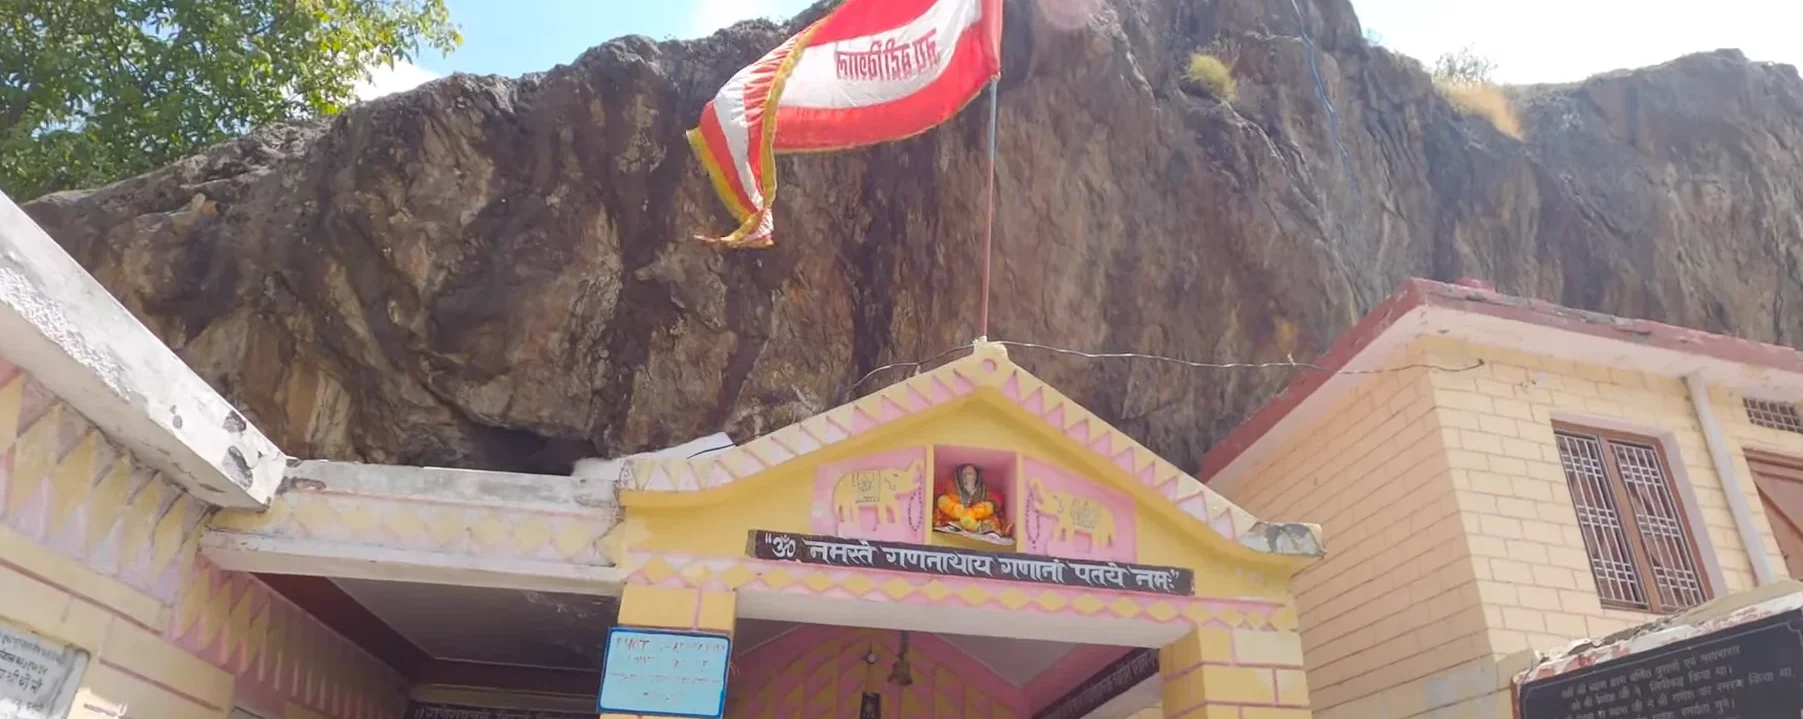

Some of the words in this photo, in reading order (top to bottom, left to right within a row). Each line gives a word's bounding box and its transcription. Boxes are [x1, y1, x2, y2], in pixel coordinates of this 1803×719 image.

[802, 537, 879, 565] नमस्ते
[876, 544, 993, 576] गणनाथाय
[996, 555, 1068, 583] गणानां
[1066, 561, 1129, 588] पतये
